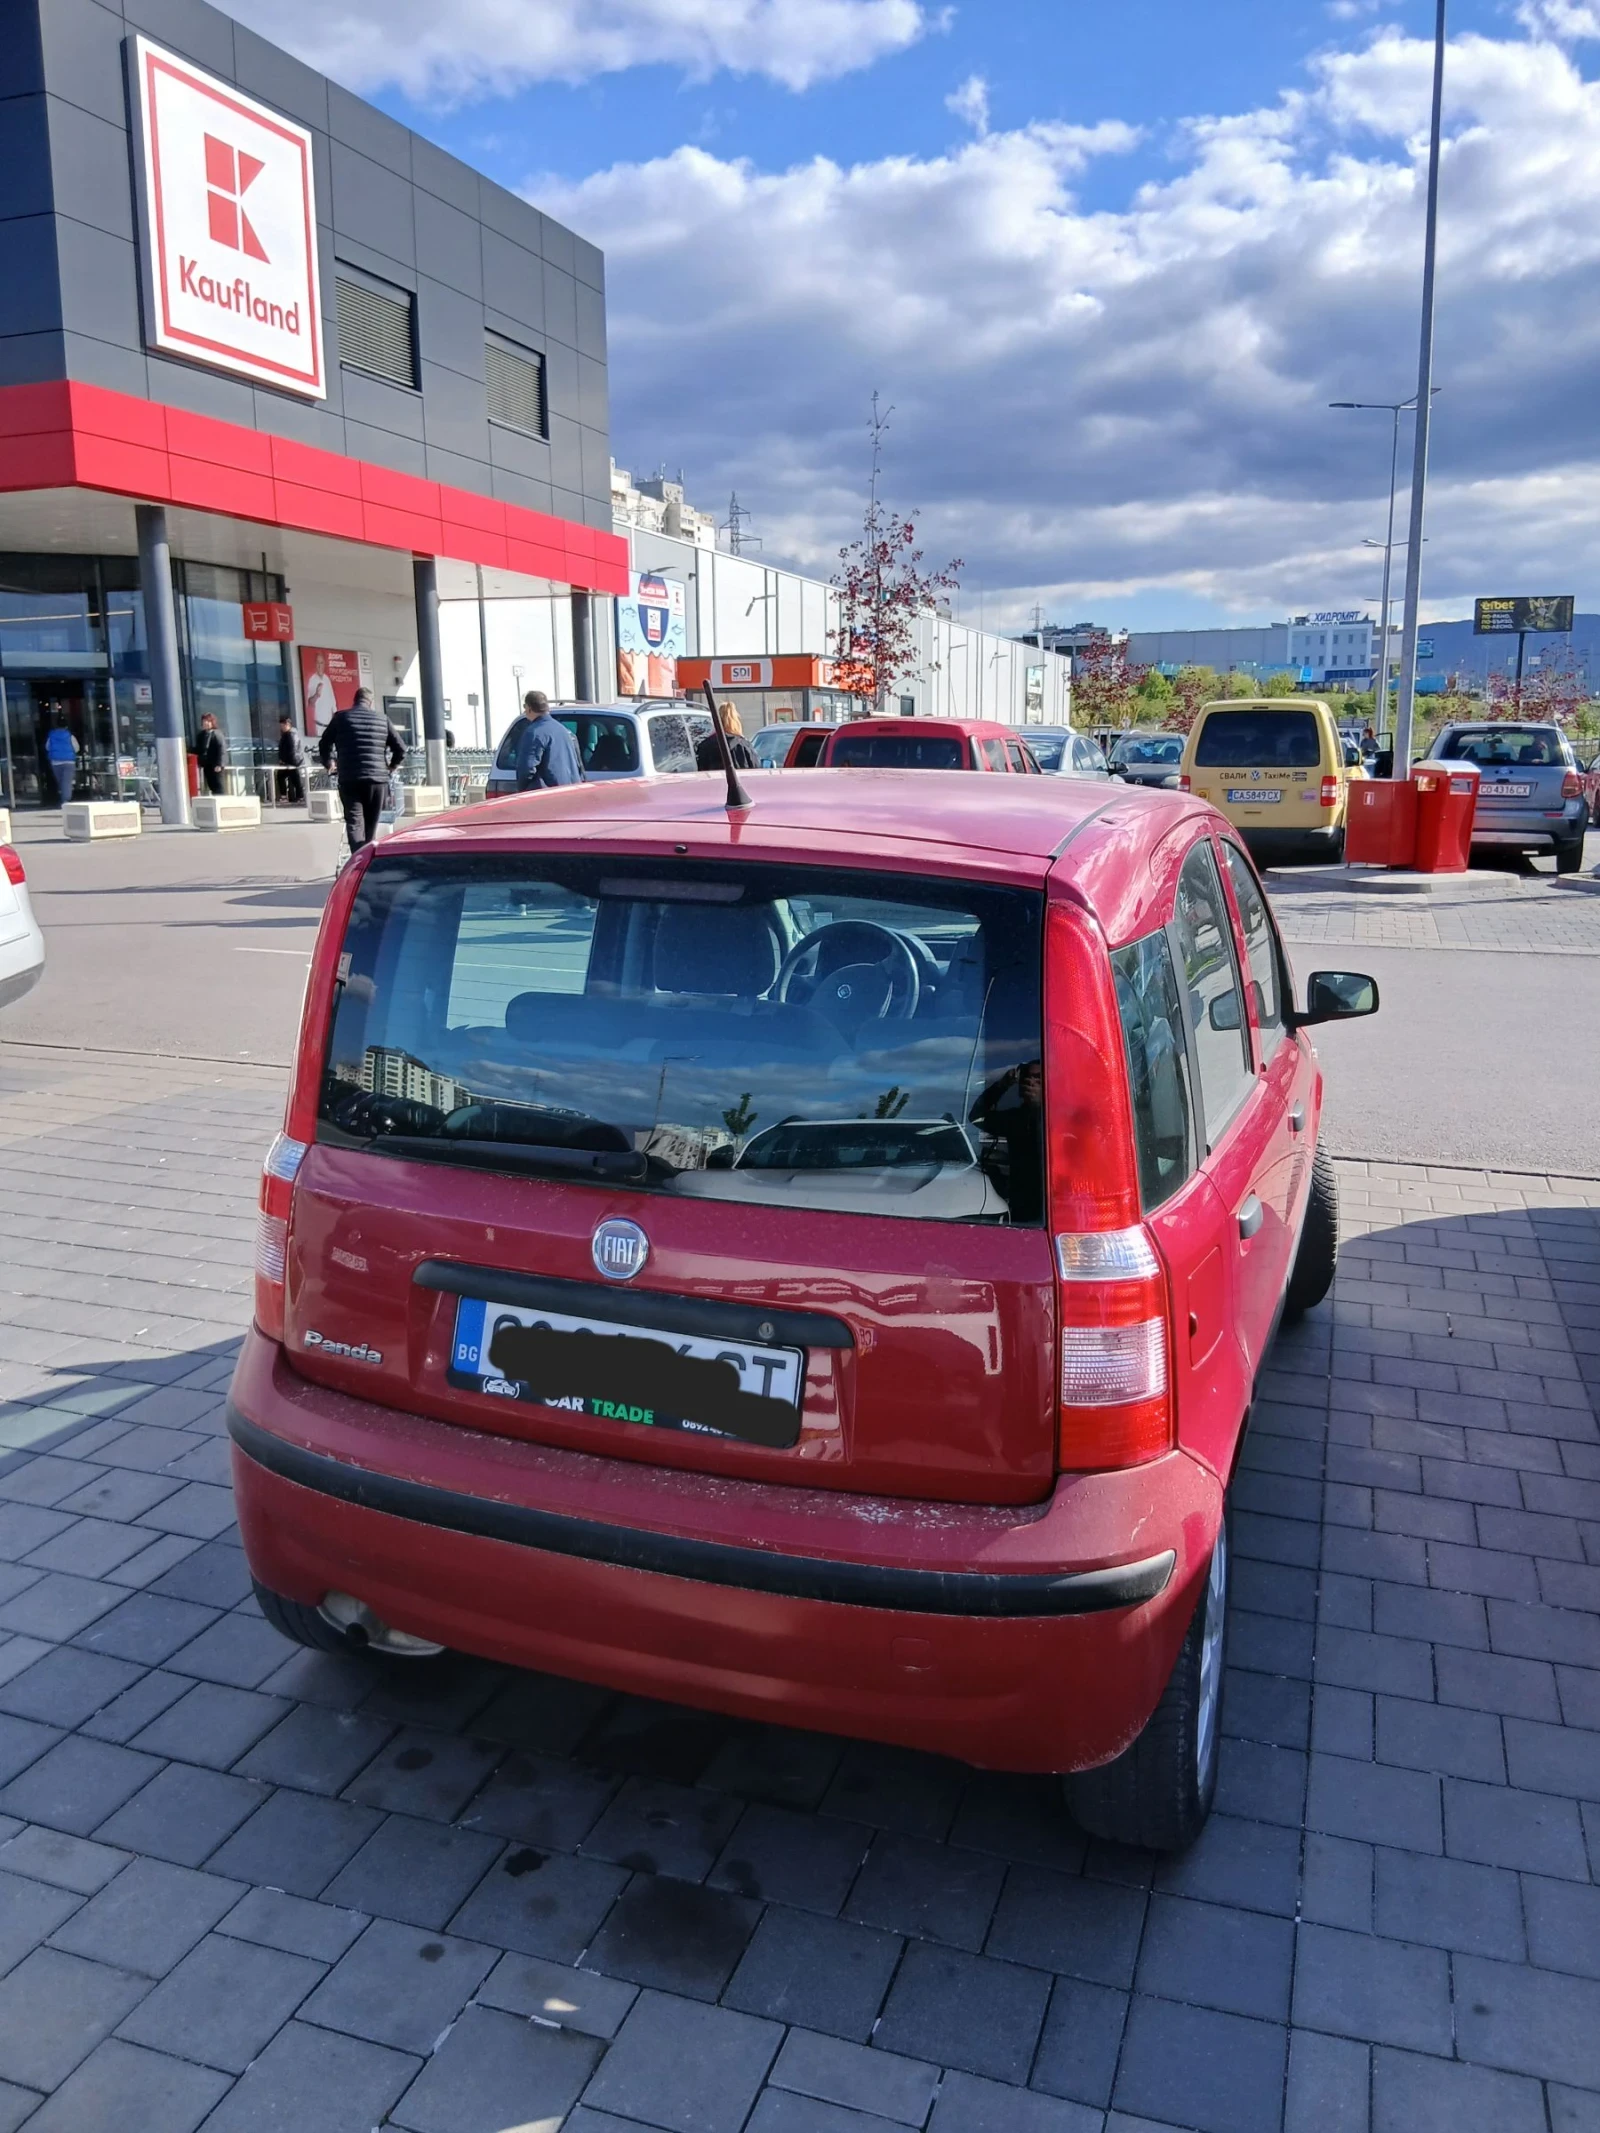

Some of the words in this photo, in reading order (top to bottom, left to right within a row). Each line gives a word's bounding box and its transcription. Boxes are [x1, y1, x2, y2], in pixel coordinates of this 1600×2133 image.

[179, 255, 300, 335] Kaufland
[733, 667, 750, 677] SDI
[1219, 772, 1247, 780] СВАЛИ
[1264, 772, 1291, 780] TaxiMe
[604, 1236, 636, 1264] FIAT
[304, 1330, 382, 1364] Panda
[458, 1343, 478, 1362] BG
[591, 1398, 654, 1425] TRADE
